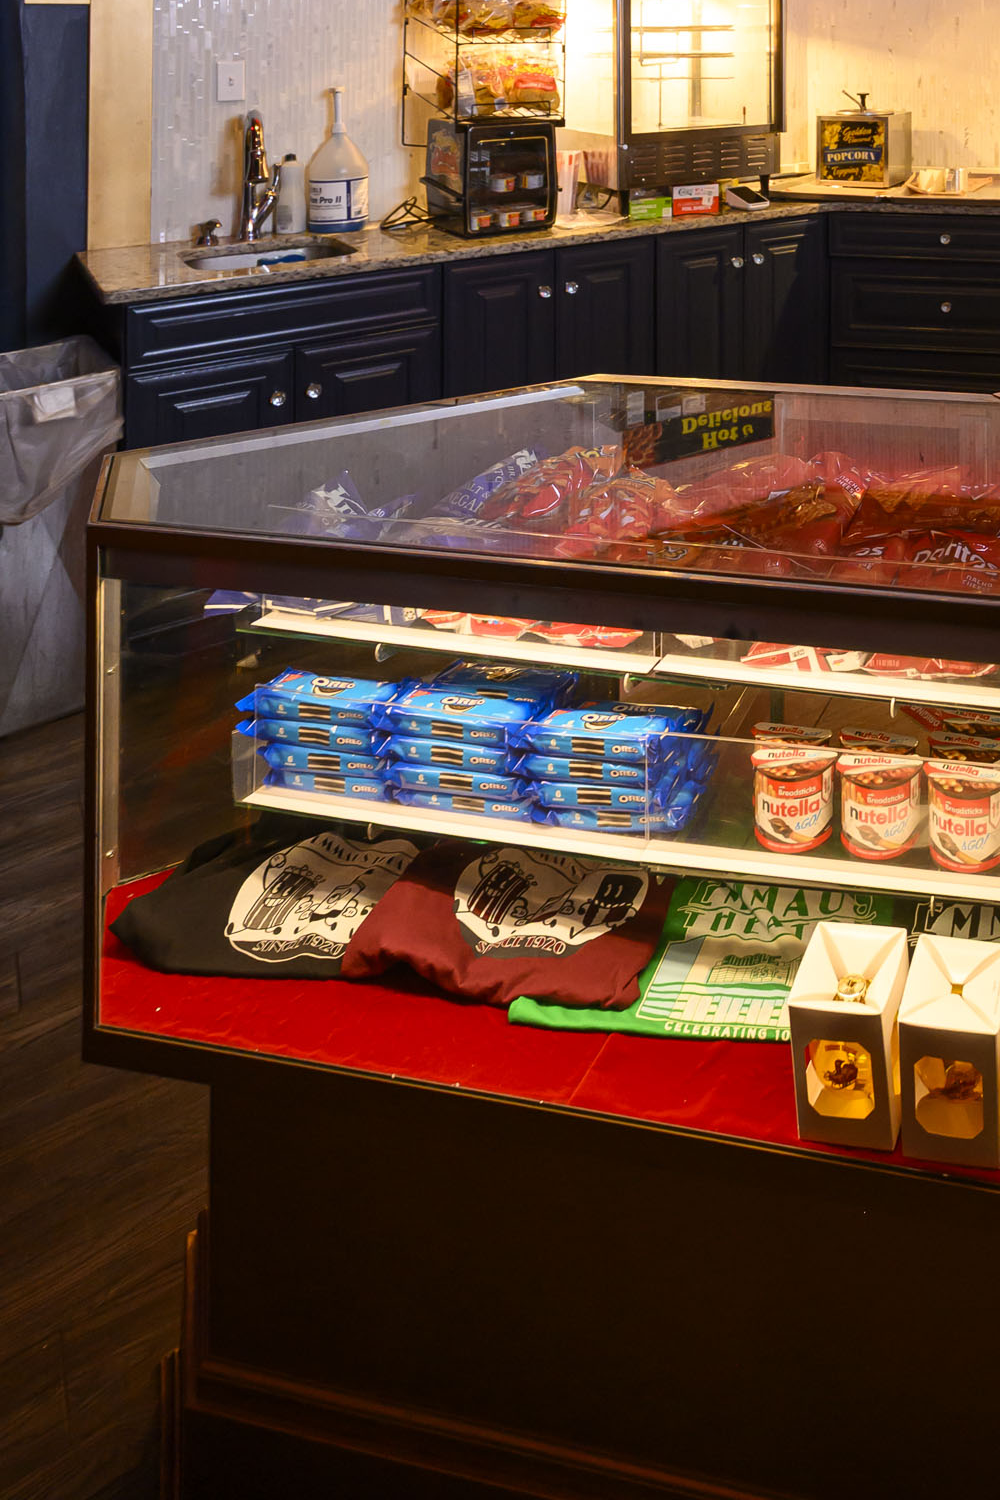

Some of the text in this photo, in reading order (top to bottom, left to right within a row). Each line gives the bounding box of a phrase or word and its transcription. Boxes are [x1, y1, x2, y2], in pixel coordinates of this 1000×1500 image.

[913, 543, 999, 576] Doritos
[312, 677, 355, 689] OREO
[440, 696, 485, 706] OREO
[581, 714, 627, 722] OREO
[336, 737, 362, 746] OREO
[768, 750, 806, 758] nutella
[470, 757, 496, 765] OREO
[610, 770, 637, 778] OREO
[942, 763, 978, 776] nutella
[778, 785, 817, 797] Breadsticks
[618, 795, 646, 803] OREO
[867, 793, 905, 805] Breadsticks
[492, 804, 519, 813] OREO
[762, 799, 820, 817] nutella
[850, 805, 908, 825] nutella
[932, 811, 987, 836] nutella
[304, 933, 344, 955] 1920
[525, 936, 567, 955] 1920
[664, 1021, 767, 1040] CELEBRATING
